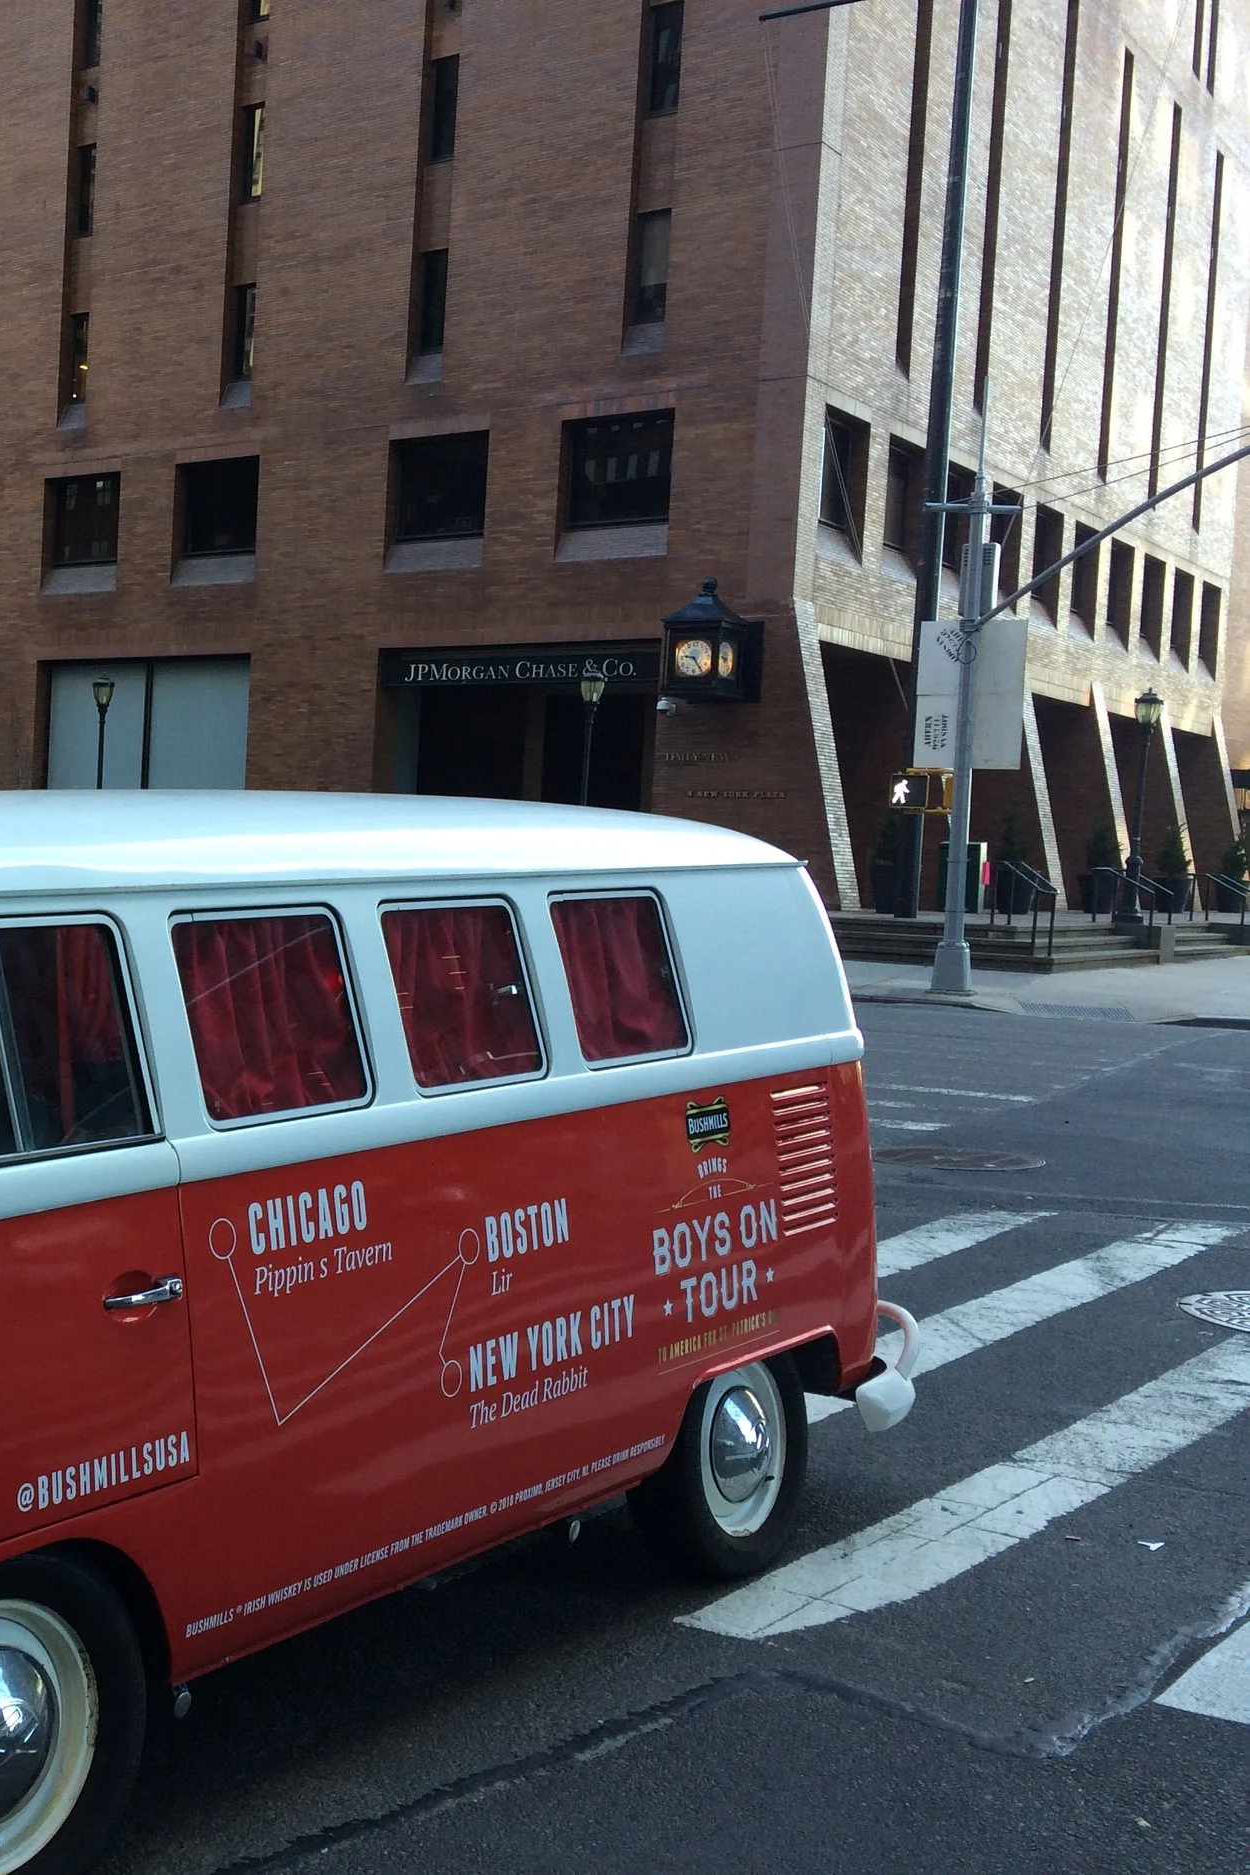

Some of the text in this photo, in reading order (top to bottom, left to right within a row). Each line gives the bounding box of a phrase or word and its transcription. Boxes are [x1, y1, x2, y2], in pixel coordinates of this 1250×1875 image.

[697, 790, 719, 798] NEW
[723, 790, 749, 798] YORK
[753, 790, 786, 798] PLAZA
[688, 1112, 729, 1135] BUSHMILLS
[697, 1157, 728, 1179] BRINGS
[708, 1184, 722, 1200] THE
[248, 1180, 368, 1256] CHICAGO
[485, 1197, 570, 1262] BOSTON
[652, 1198, 779, 1276] BOYS ON
[254, 1256, 314, 1297] Pippin
[333, 1241, 393, 1274] Tavern
[491, 1269, 513, 1296] Lir
[680, 1259, 759, 1323] TOUR
[469, 1294, 636, 1393] NEW YORK CITY
[658, 1346, 667, 1364] TO
[670, 1335, 702, 1359] AMERICA
[704, 1328, 717, 1347] FOR
[732, 1312, 766, 1337] PATRICK'S
[470, 1366, 589, 1429] The Dead Rabbit
[17, 1431, 191, 1513] @BUSHMILLSUSA
[186, 1606, 233, 1638] BUSHMILLS
[244, 1594, 265, 1615] IRISH
[268, 1579, 301, 1605] WHISKEY
[304, 1575, 311, 1591] IS
[313, 1567, 332, 1587] USED
[334, 1557, 358, 1579] UNDER
[360, 1545, 388, 1568] LICENSE
[390, 1536, 409, 1556] FROM
[411, 1531, 422, 1547] THE
[425, 1515, 462, 1541] TRADEMARK
[498, 1494, 513, 1511] 2018
[545, 1473, 565, 1492] JERSEY
[591, 1454, 612, 1474] PLEASE
